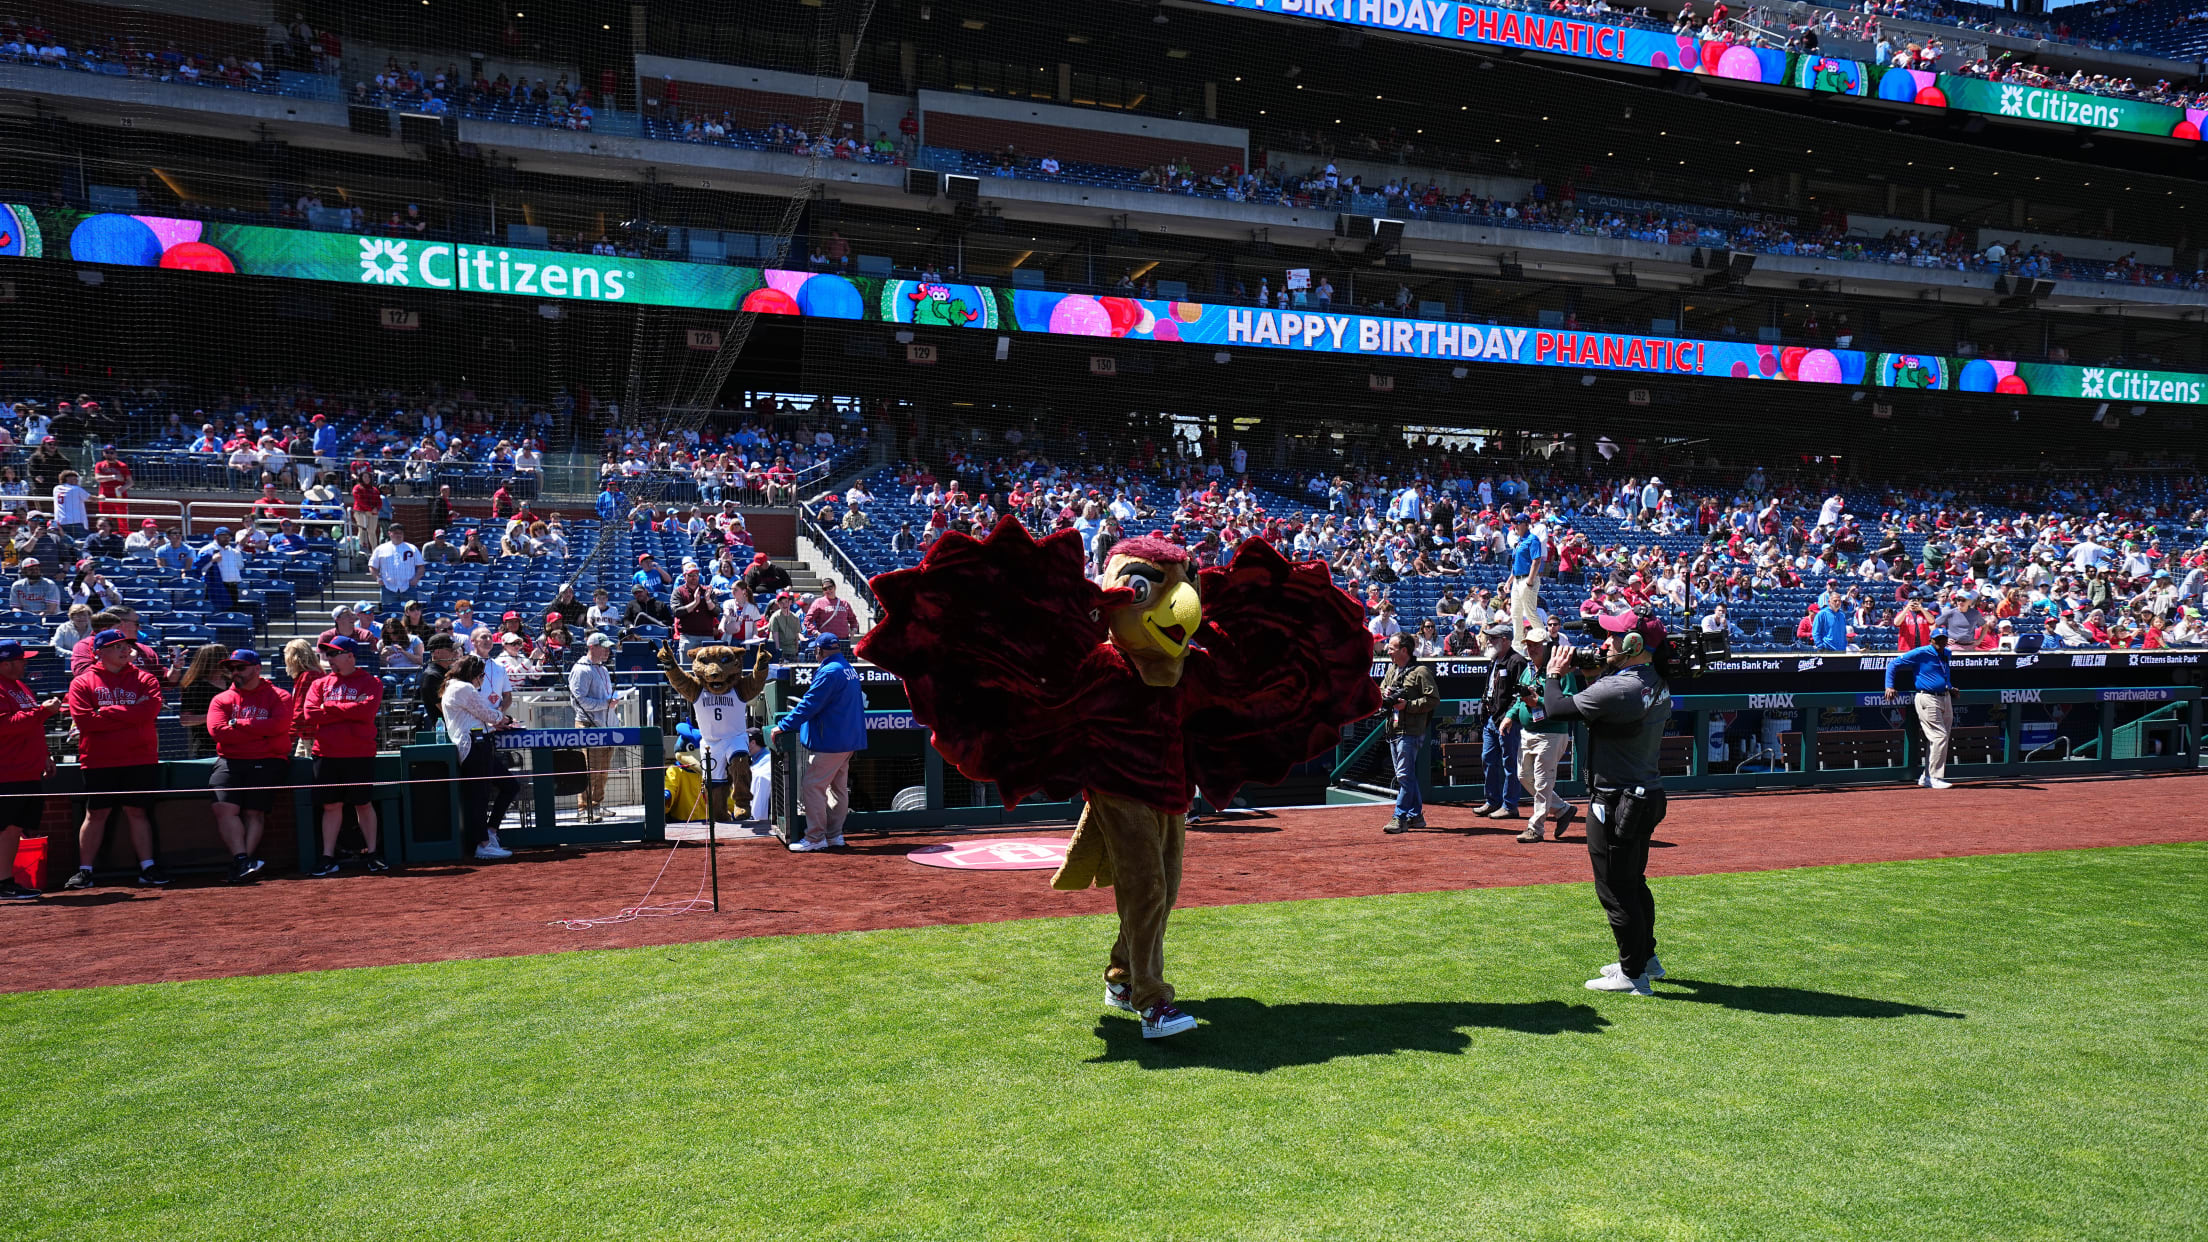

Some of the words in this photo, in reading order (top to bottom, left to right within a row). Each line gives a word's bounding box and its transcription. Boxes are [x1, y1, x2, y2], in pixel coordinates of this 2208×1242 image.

[1456, 7, 1626, 59] PHANATIC!
[2027, 90, 2119, 128] Citizens
[1587, 195, 1662, 211] CADILLAC
[1667, 204, 1700, 216] HALL
[1705, 208, 1719, 218] OF
[1726, 210, 1761, 222] FAME
[1764, 214, 1798, 225] CLUB
[418, 246, 625, 300] Citizens
[391, 310, 408, 325] 127
[694, 332, 713, 346] 128
[1227, 308, 1350, 349] HAPPY
[1358, 318, 1527, 361] BIRTHDAY
[1535, 332, 1705, 373] PHANATIC!
[912, 346, 931, 359] 129
[1095, 360, 1112, 372] 130
[2108, 371, 2200, 403] Citizens
[403, 550, 413, 562] P
[1741, 660, 1762, 670] Bank
[1762, 660, 1780, 670] Park
[1965, 658, 1982, 667] Bank
[1984, 657, 1999, 667] Park
[2140, 655, 2166, 664] Citizens
[2167, 655, 2182, 664] Bank
[2184, 655, 2198, 663] Park
[843, 668, 859, 681] STA
[867, 670, 896, 681] Bank
[1452, 664, 1488, 675] Citizens
[703, 696, 734, 707] VILLANOVA
[2103, 689, 2158, 701] smartwater
[714, 707, 722, 721] 6
